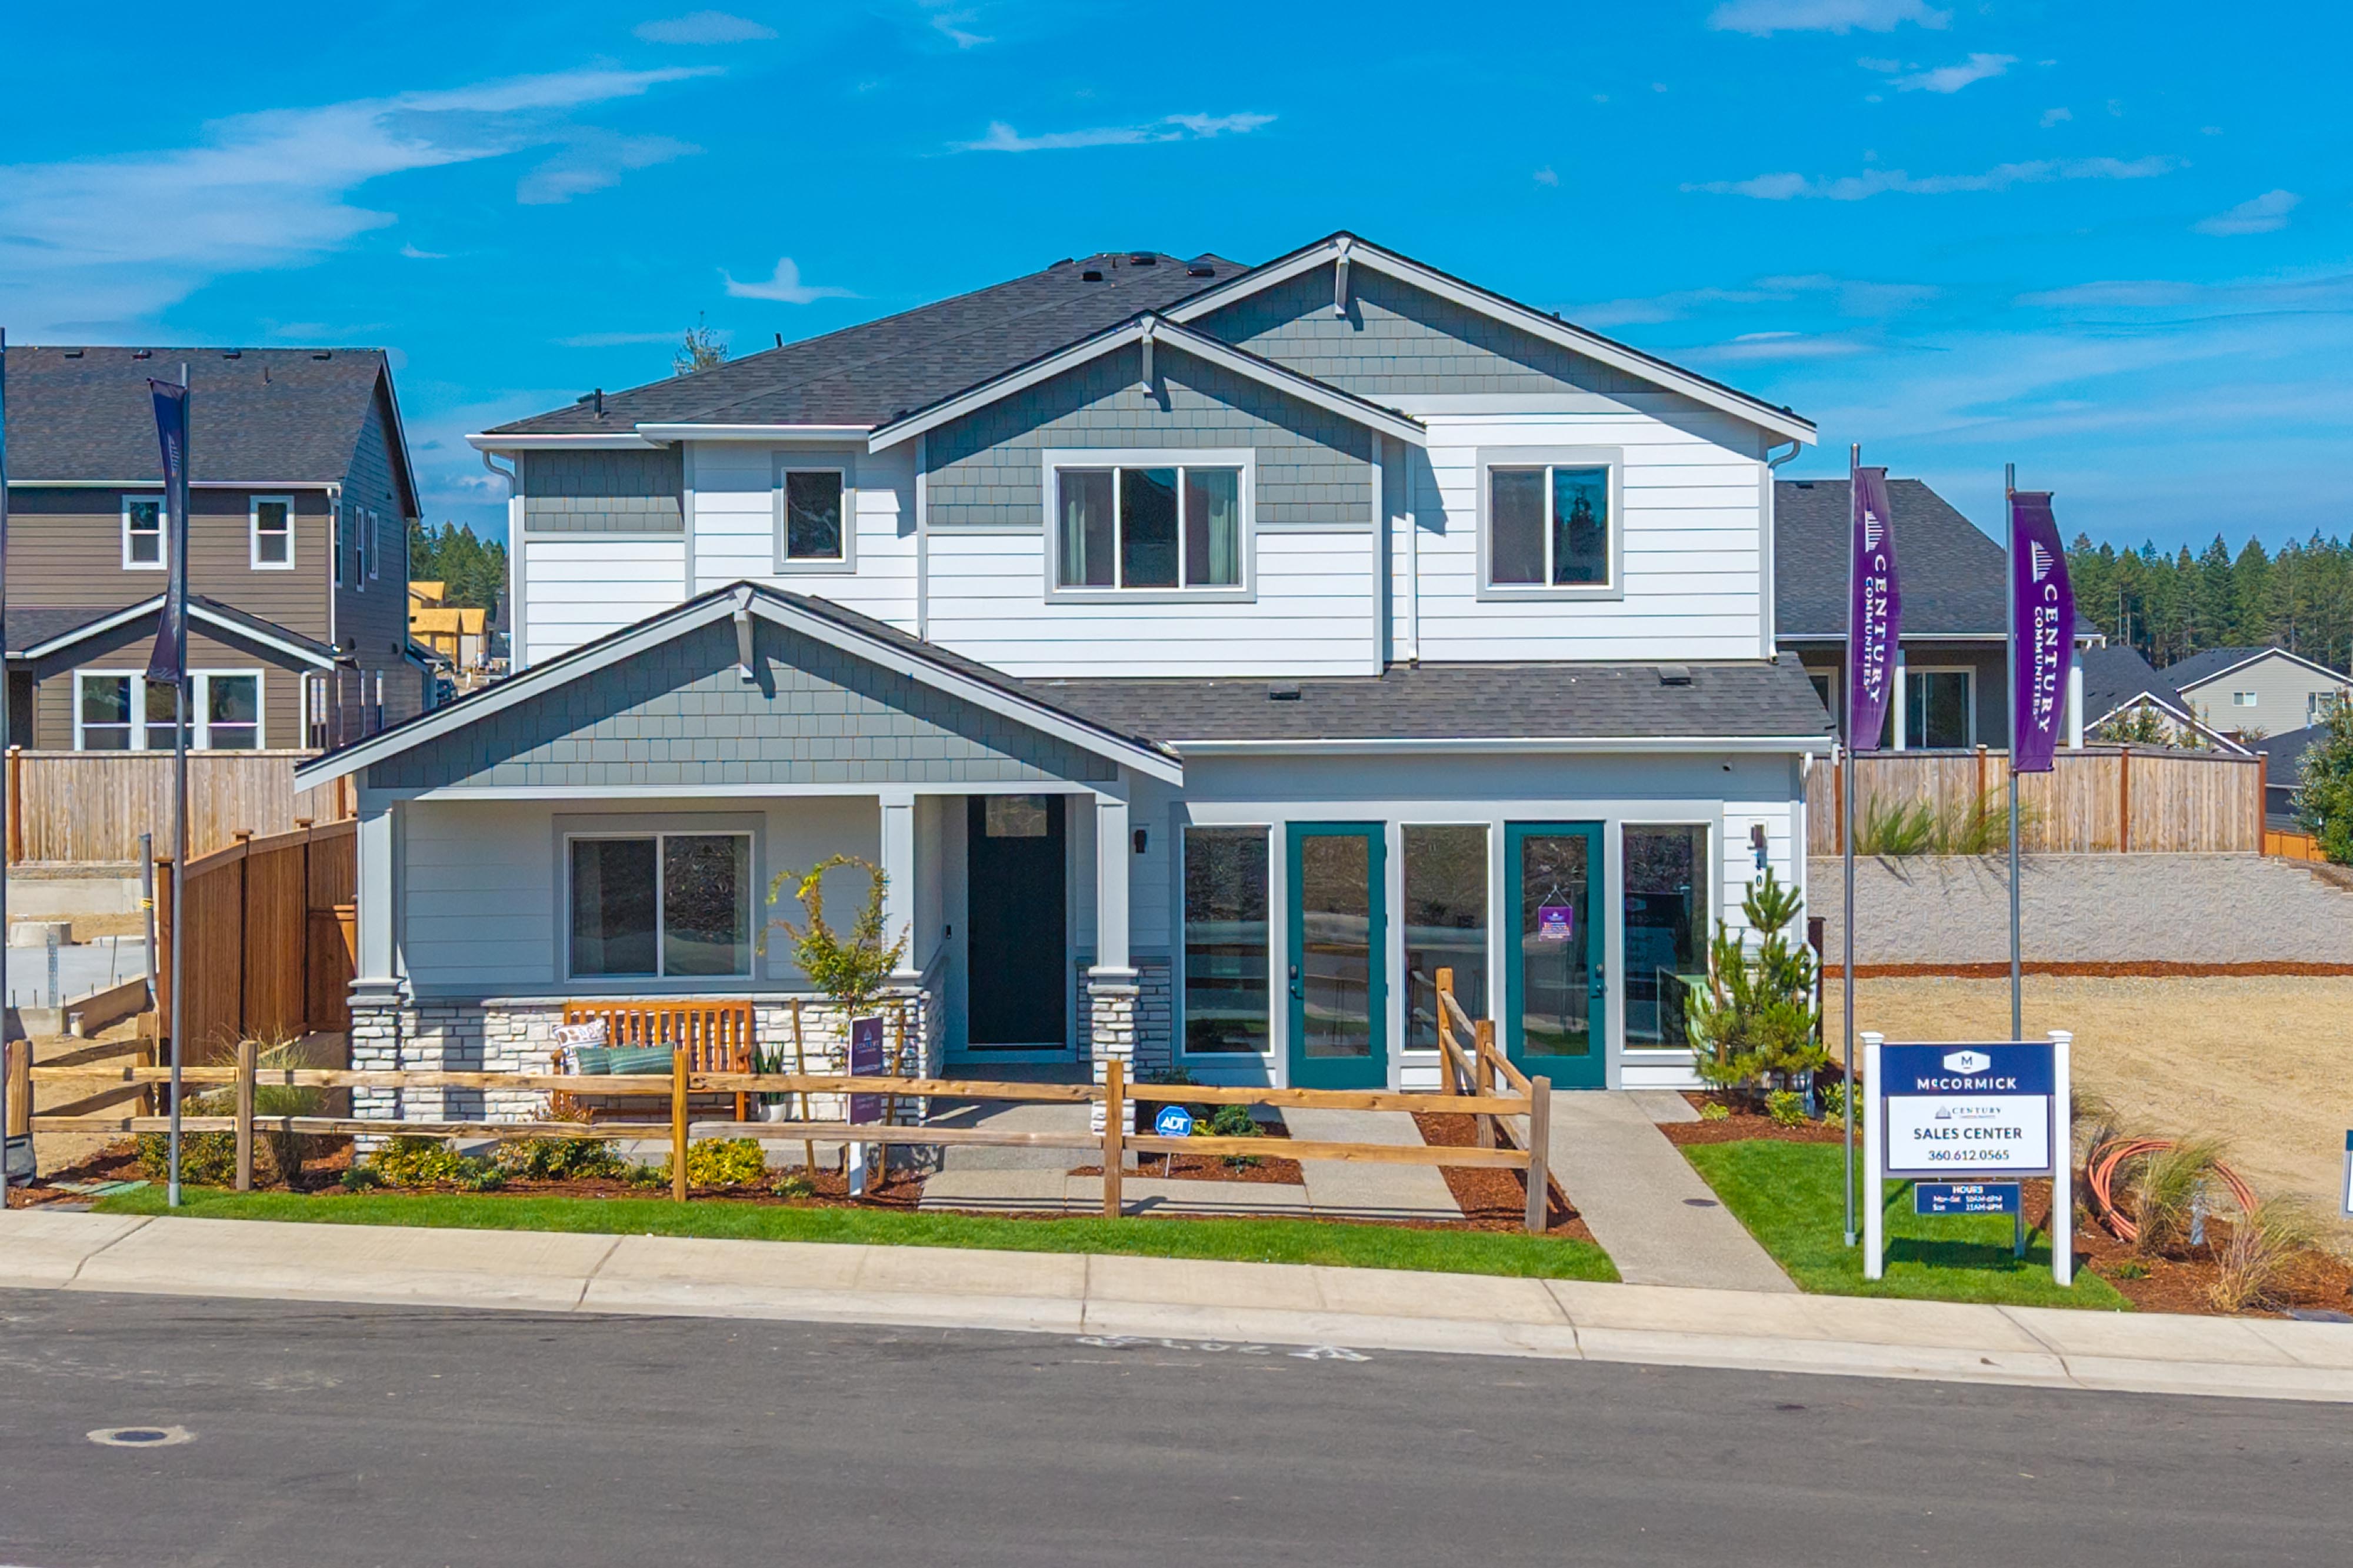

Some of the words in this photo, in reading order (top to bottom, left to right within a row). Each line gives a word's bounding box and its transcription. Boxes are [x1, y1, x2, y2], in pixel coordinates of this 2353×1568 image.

[1864, 576, 1874, 688] COMMUNITIES
[1870, 554, 1887, 702] CENTURY
[2039, 583, 2058, 732] CENTURY
[2033, 606, 2043, 716] COMMUNITIES
[1961, 1056, 1972, 1065] M
[1161, 1116, 1188, 1130] ADT
[1914, 1128, 1959, 1139] SALES
[1964, 1127, 2022, 1139] CENTER
[1928, 1150, 2009, 1160] 360.612.0565
